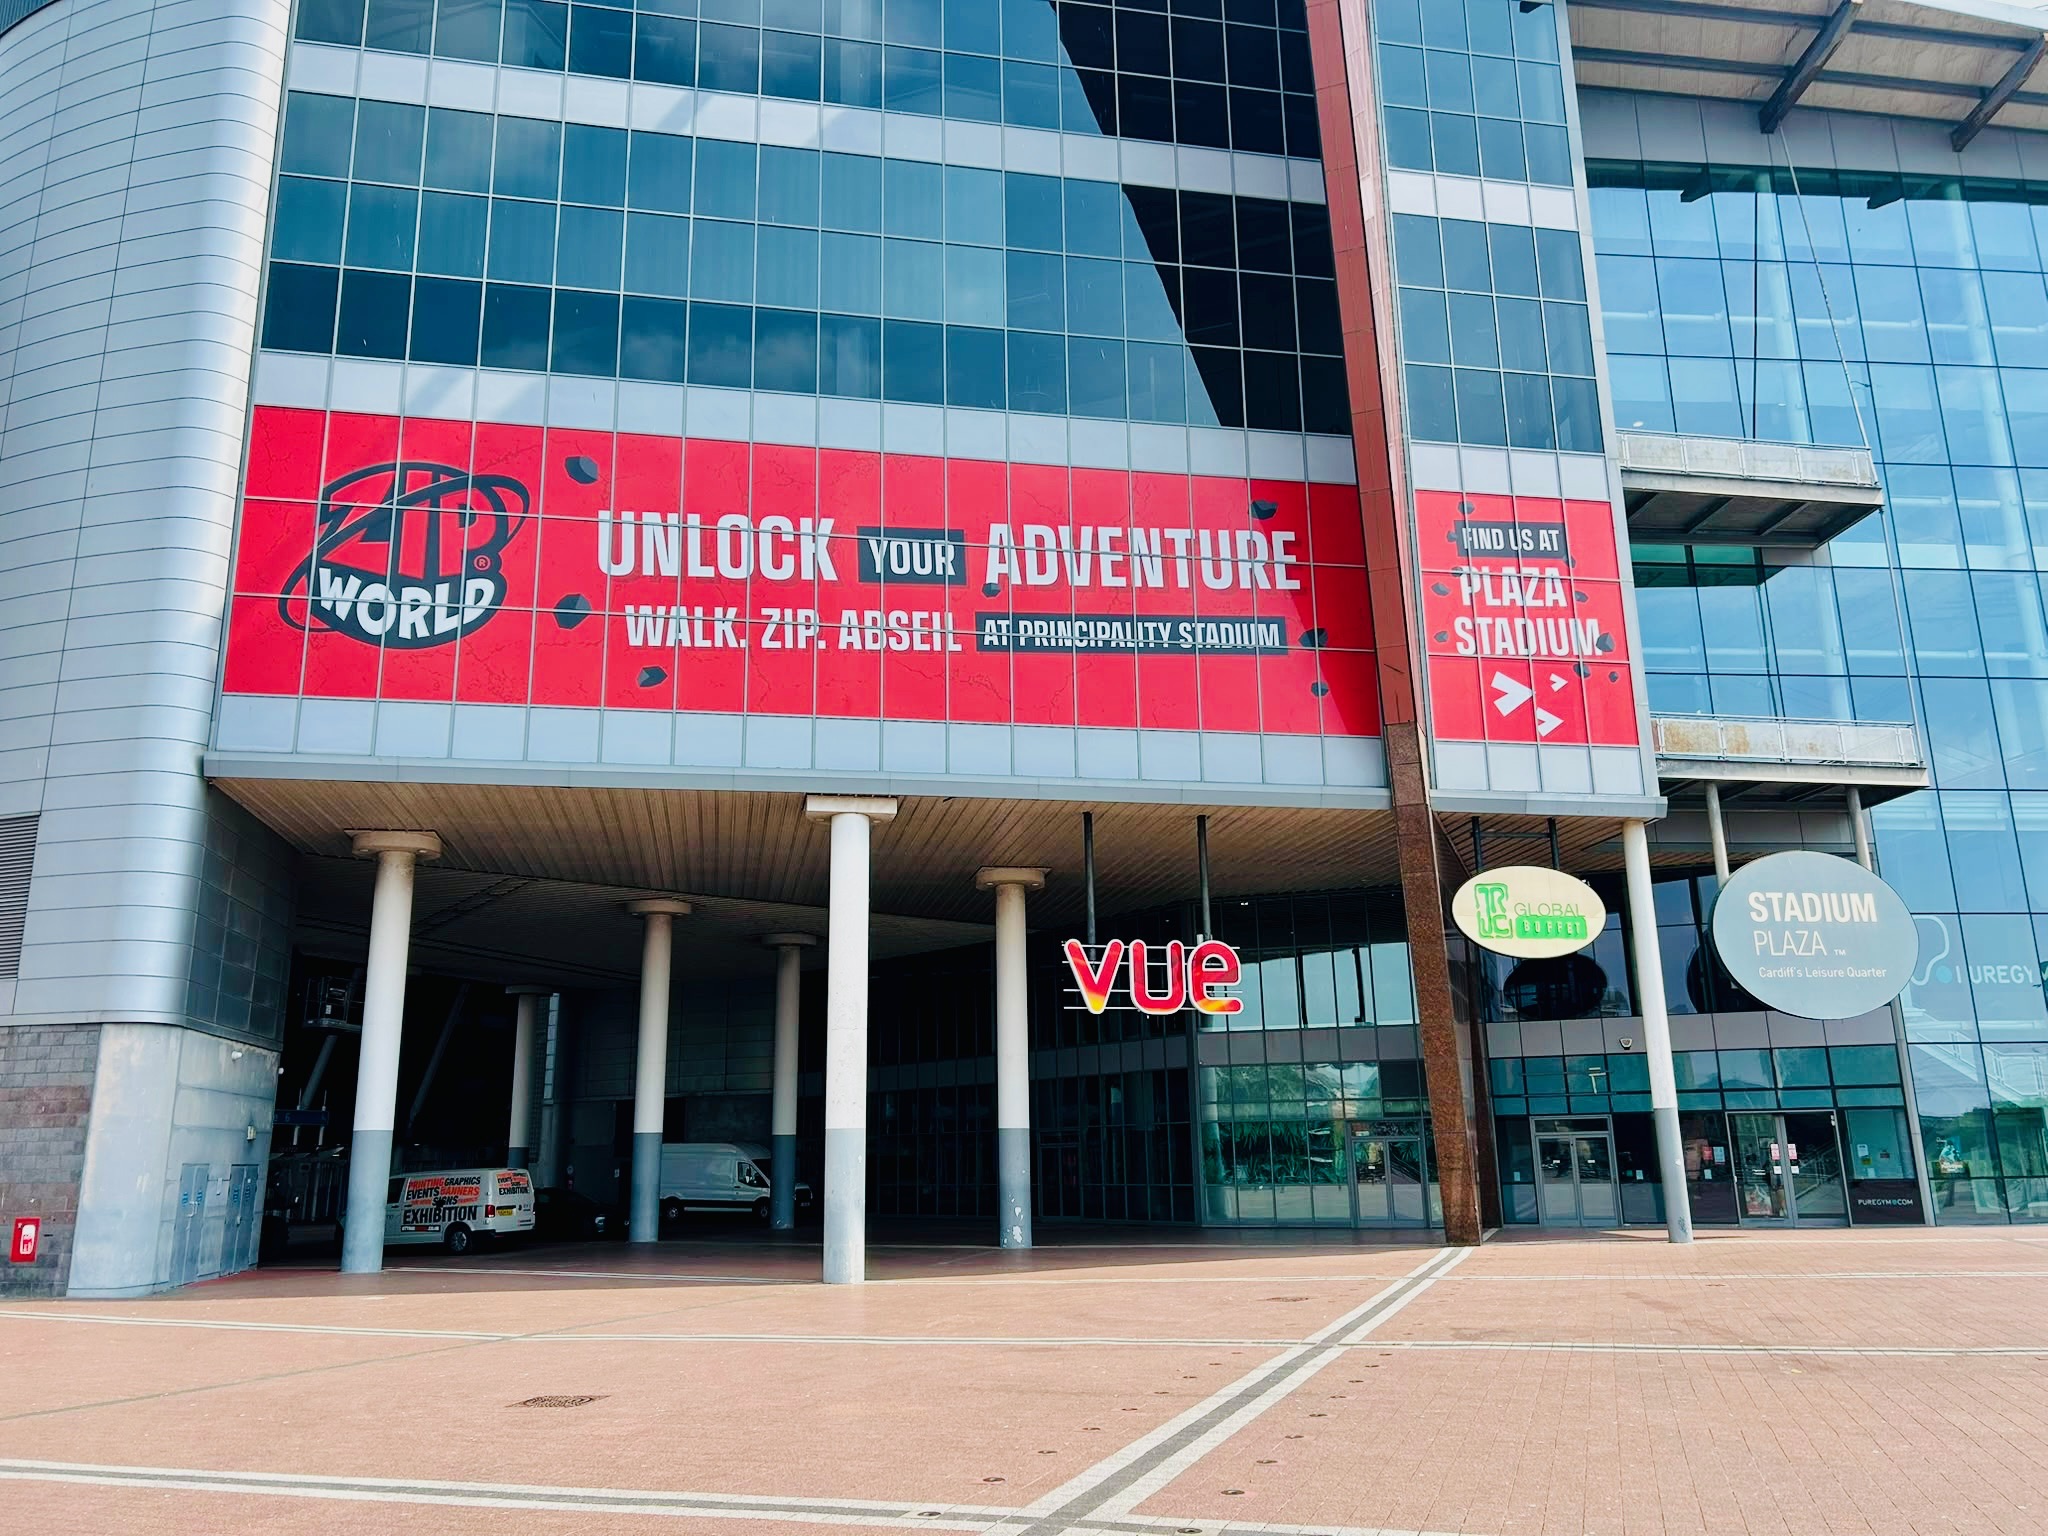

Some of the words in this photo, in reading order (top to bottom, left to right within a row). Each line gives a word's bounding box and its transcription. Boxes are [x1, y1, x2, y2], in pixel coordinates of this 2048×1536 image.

[318, 468, 497, 580] ZIP
[598, 510, 838, 581] UNLOCK
[869, 539, 956, 576] YOUR
[985, 523, 1301, 590] ADVENTURE
[1462, 527, 1504, 550] FIND
[1509, 528, 1534, 551] US
[1539, 529, 1559, 551] AT
[1459, 566, 1568, 607] PLAZA
[319, 568, 495, 640] WORLD
[624, 605, 747, 648] WALK.
[760, 607, 827, 649] ZIP.
[838, 609, 962, 652] ABSEIL
[983, 619, 1010, 646] AT
[1019, 620, 1172, 649] PRINCIPALITY
[1179, 622, 1280, 649] STADIUM
[1454, 616, 1603, 656] STADIUM
[1514, 903, 1585, 918] GLOBAL
[1748, 891, 1877, 923] STADIUM
[1522, 920, 1581, 936] BUFFET
[1753, 930, 1827, 956] PLAZA
[1758, 966, 1803, 978] Cardiff's
[1805, 967, 1844, 978] Leisure
[1847, 966, 1887, 978] Quarter
[406, 1187, 440, 1200] EVENTS
[440, 1186, 480, 1196] BANNERS
[408, 1177, 444, 1189] PRINTING
[444, 1176, 481, 1187] GRAPHICS
[432, 1196, 459, 1206] SIGNS
[403, 1206, 478, 1225] EXHIBITION
